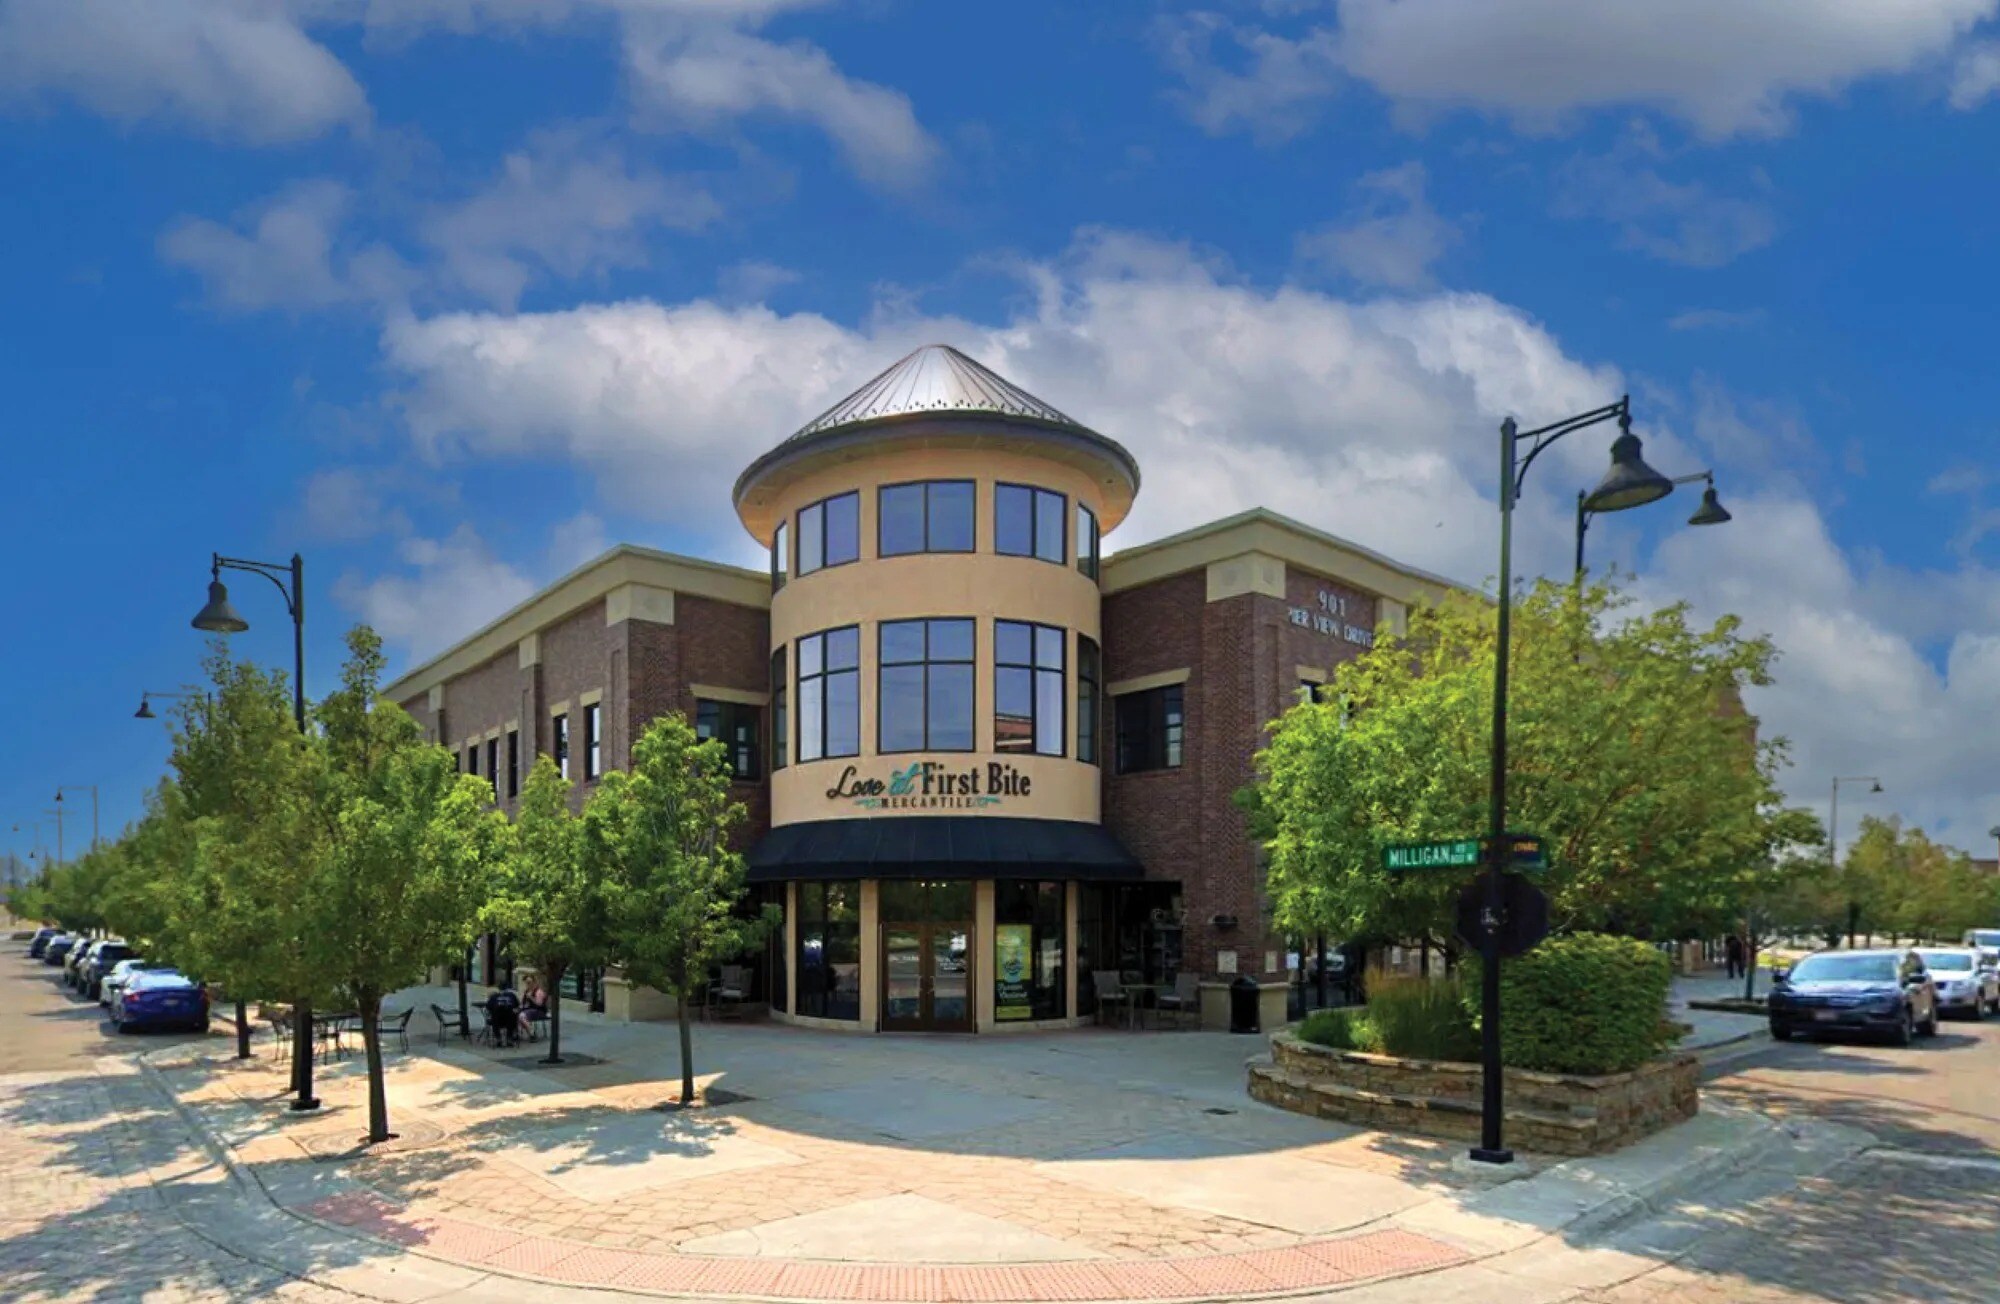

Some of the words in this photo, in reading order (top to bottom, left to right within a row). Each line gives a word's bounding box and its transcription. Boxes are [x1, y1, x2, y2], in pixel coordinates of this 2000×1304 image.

[1319, 590, 1345, 617] 901
[826, 765, 886, 799] Love
[921, 761, 981, 796] First
[987, 761, 1031, 796] Bite
[881, 796, 973, 809] MERCANTILE
[1388, 846, 1450, 866] MILLIGAN
